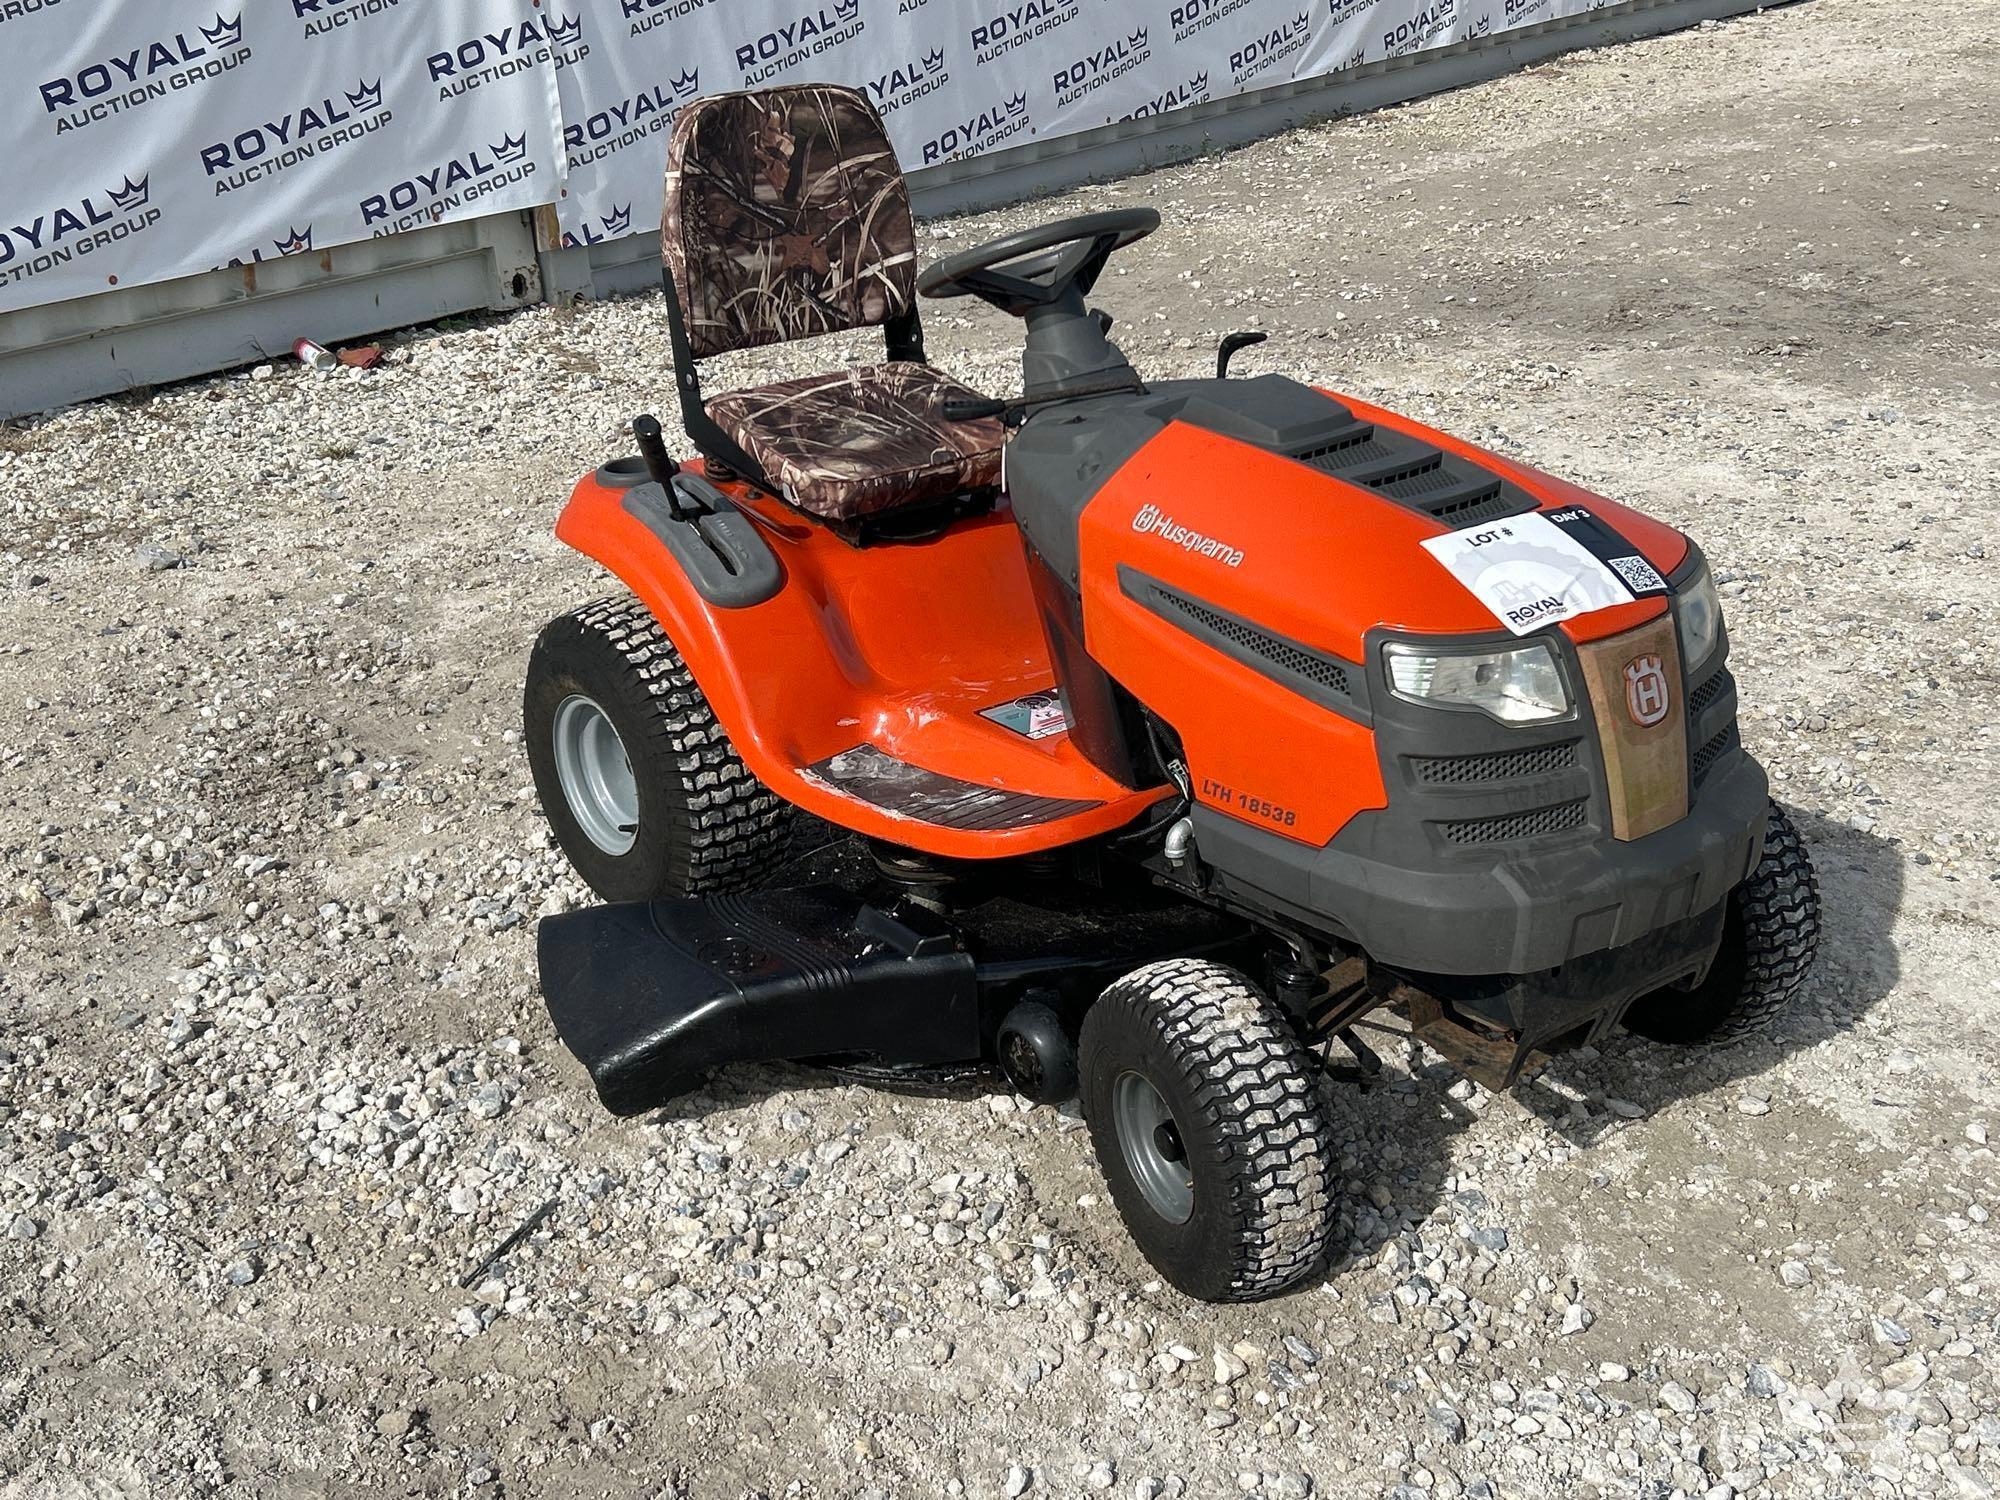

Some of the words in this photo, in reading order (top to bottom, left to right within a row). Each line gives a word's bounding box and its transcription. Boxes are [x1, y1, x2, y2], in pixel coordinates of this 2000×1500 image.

[304, 0, 398, 39] AUCTION
[971, 0, 1054, 50] ROYAL
[976, 28, 1033, 66] AUCTION
[1035, 7, 1079, 36] GROUP
[1174, 10, 1220, 44] AUCTION
[1332, 0, 1373, 27] AUCTION
[1383, 7, 1440, 51] ROYAL
[1426, 15, 1458, 39] GROUP
[735, 10, 836, 71] ROYAL
[745, 46, 811, 88] AUCTION
[812, 21, 865, 54] GROUP
[1229, 24, 1293, 73] ROYAL
[1233, 53, 1277, 87] AUCTION
[1277, 32, 1311, 60] GROUP
[39, 33, 206, 113] ROYAL
[56, 80, 167, 136] AUCTION
[169, 47, 252, 91] GROUP
[440, 55, 533, 102] AUCTION
[901, 73, 949, 105] GROUP
[1053, 40, 1129, 93] ROYAL
[1057, 72, 1110, 109] AUCTION
[1112, 50, 1151, 79] GROUP
[200, 99, 350, 176] ROYAL
[564, 86, 673, 151] ROYAL
[922, 107, 1006, 165] ROYAL
[986, 115, 1030, 147] GROUP
[215, 142, 315, 197] AUCTION
[318, 110, 393, 152] GROUP
[568, 125, 647, 171] AUCTION
[359, 151, 494, 226] ROYAL
[372, 193, 461, 239] AUCTION
[463, 162, 536, 202] GROUP
[75, 208, 162, 255] GROUP
[1150, 513, 1245, 568] Husqvarna
[1466, 531, 1501, 547] LOT
[1501, 527, 1514, 537] #
[1550, 511, 1580, 523] DAY
[1577, 509, 1591, 518] 3
[1506, 596, 1564, 624] ROYAL
[1203, 779, 1232, 803] LTH
[1239, 794, 1296, 826] 18538
